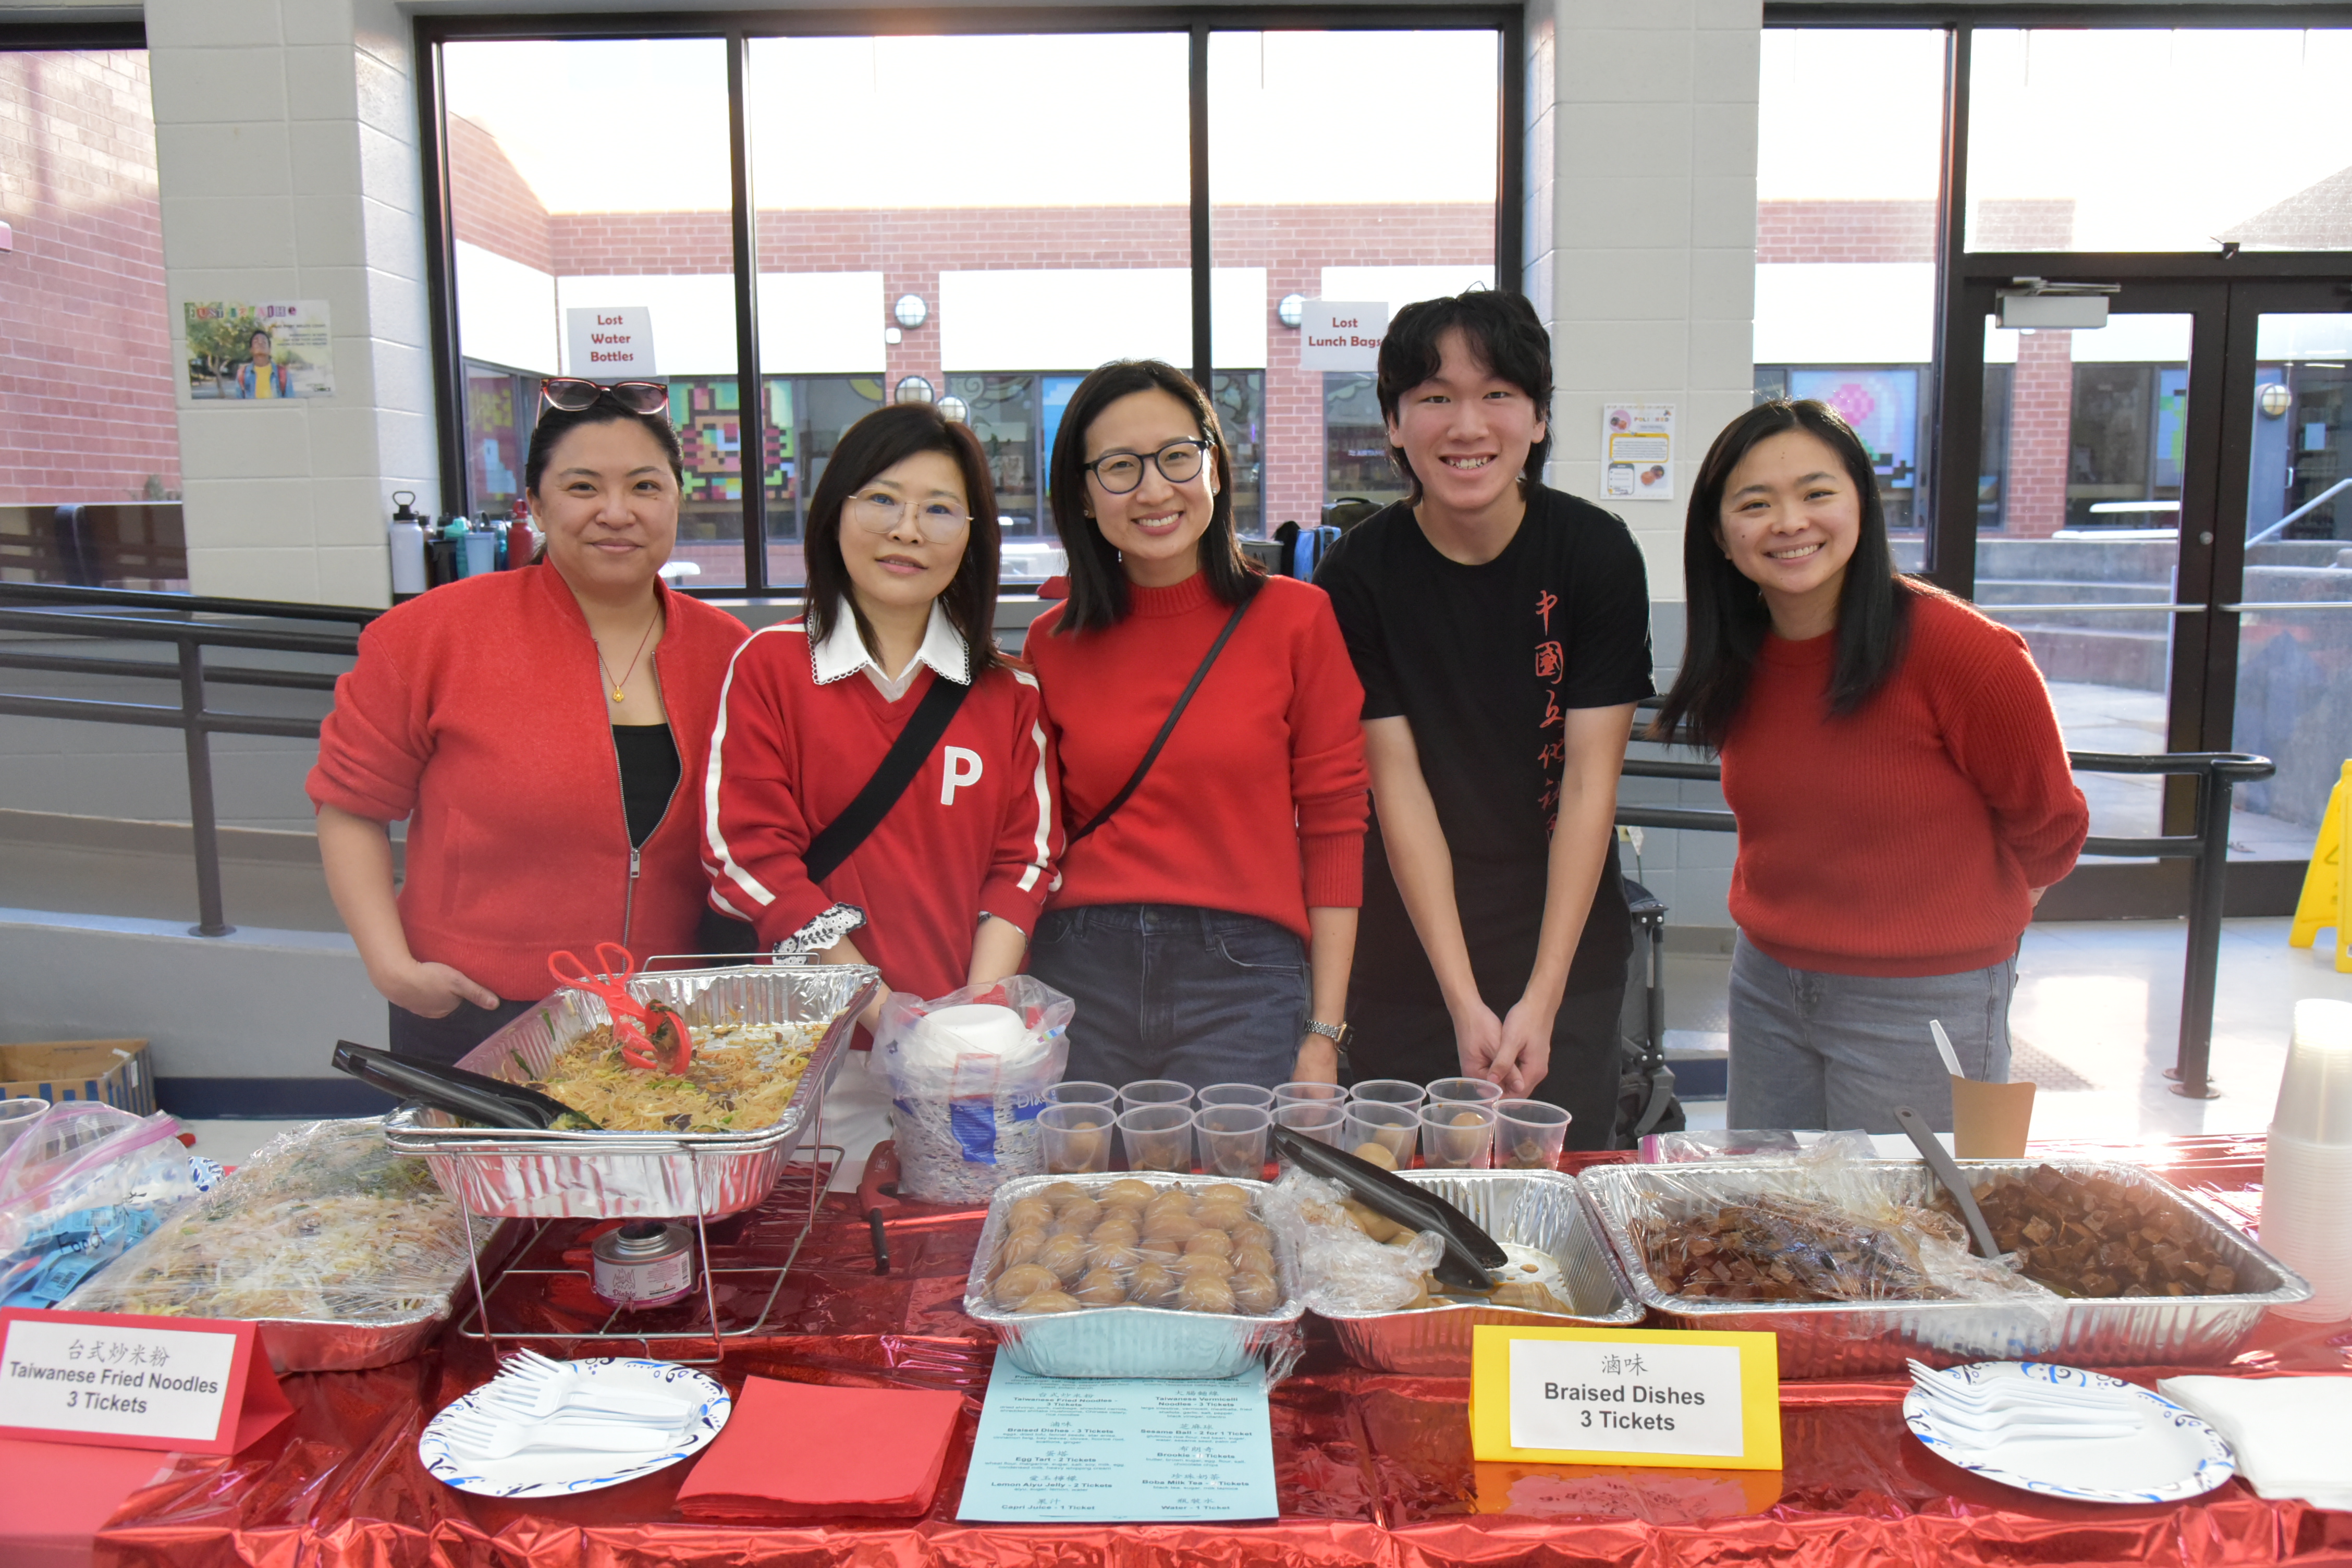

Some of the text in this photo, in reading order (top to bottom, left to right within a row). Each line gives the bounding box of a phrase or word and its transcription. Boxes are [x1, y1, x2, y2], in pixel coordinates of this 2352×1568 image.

[597, 315, 623, 325] Lost
[1332, 317, 1358, 327] Lost
[591, 334, 631, 344] Water
[1308, 336, 1381, 348] Lunch Bags
[591, 351, 633, 362] Bottles
[940, 746, 983, 805] P
[56, 1224, 105, 1254] Food
[612, 1289, 636, 1297] Diablo
[68, 1339, 170, 1367] 台式炒米粉
[1601, 1353, 1648, 1376] 滷味
[9, 1362, 218, 1394] Taiwanese Fried Noodles
[67, 1392, 147, 1414] 3 Tickets
[1545, 1382, 1705, 1405] Braised Dishes
[1581, 1410, 1675, 1430] 3 Tickets
